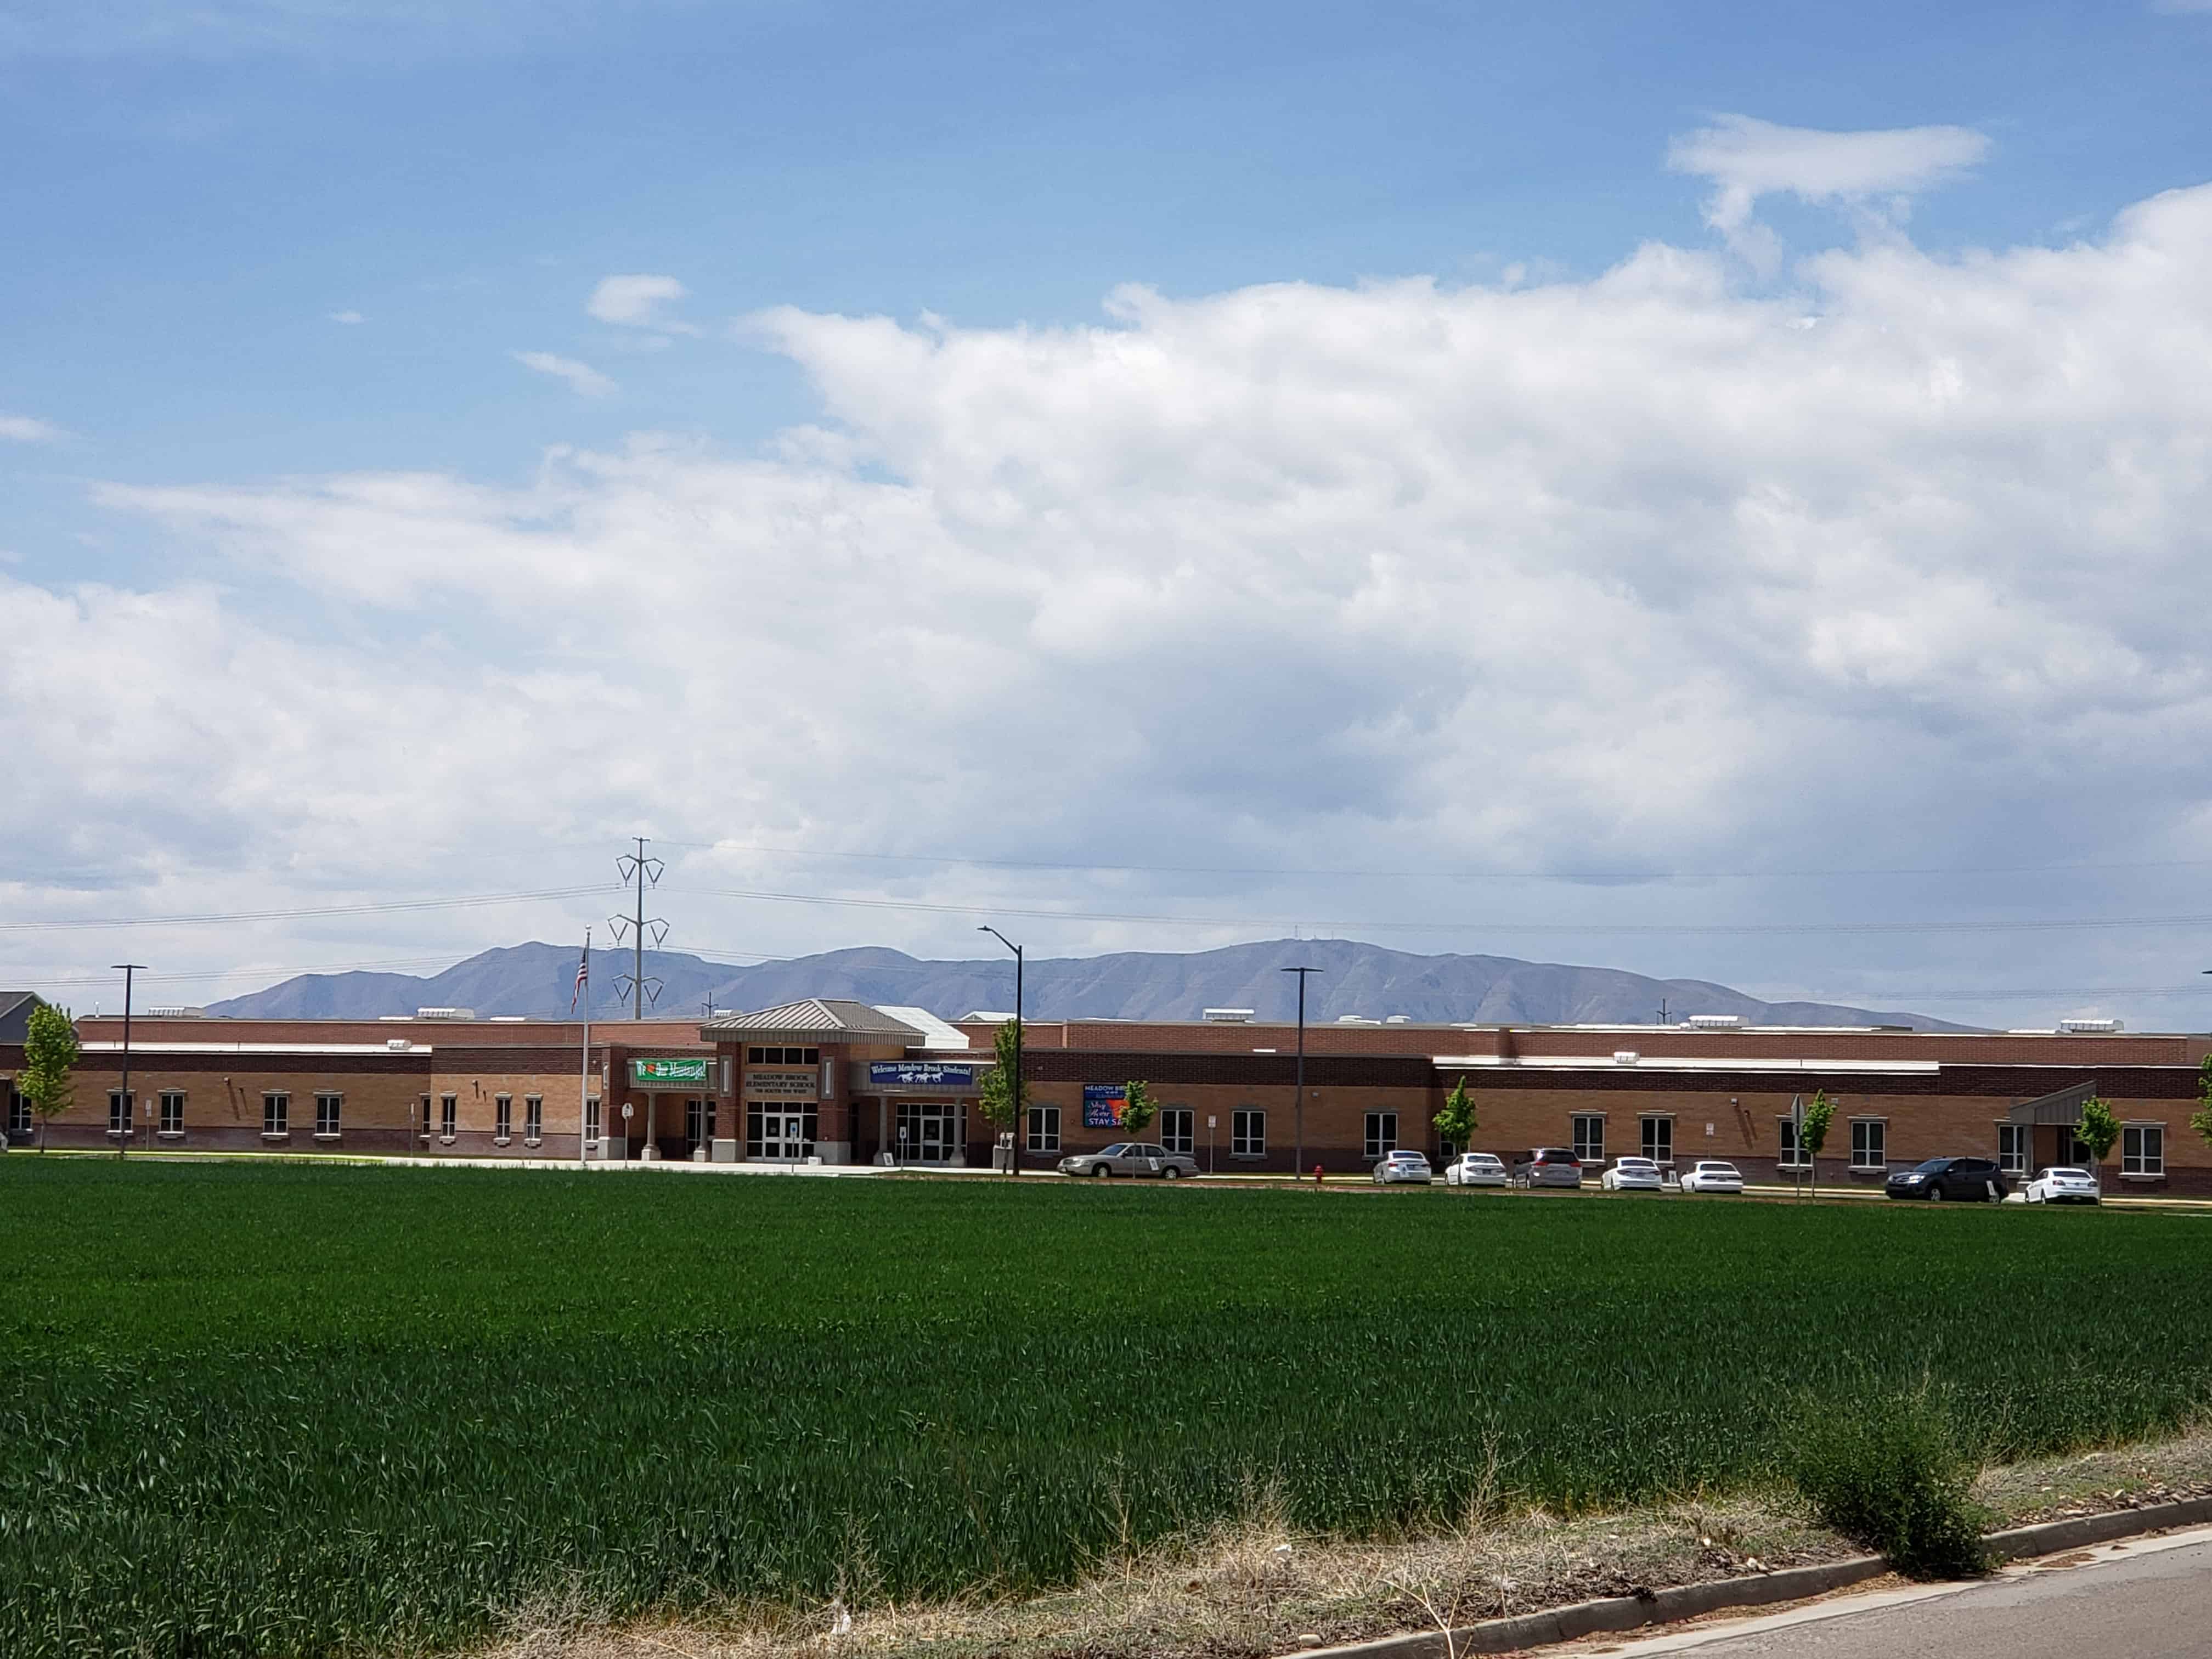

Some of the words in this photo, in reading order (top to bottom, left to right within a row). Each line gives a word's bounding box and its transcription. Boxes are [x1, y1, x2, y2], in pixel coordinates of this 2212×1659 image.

[871, 1065, 897, 1074] Welcome
[898, 1063, 922, 1071] Meadow
[943, 1065, 971, 1075] Students!
